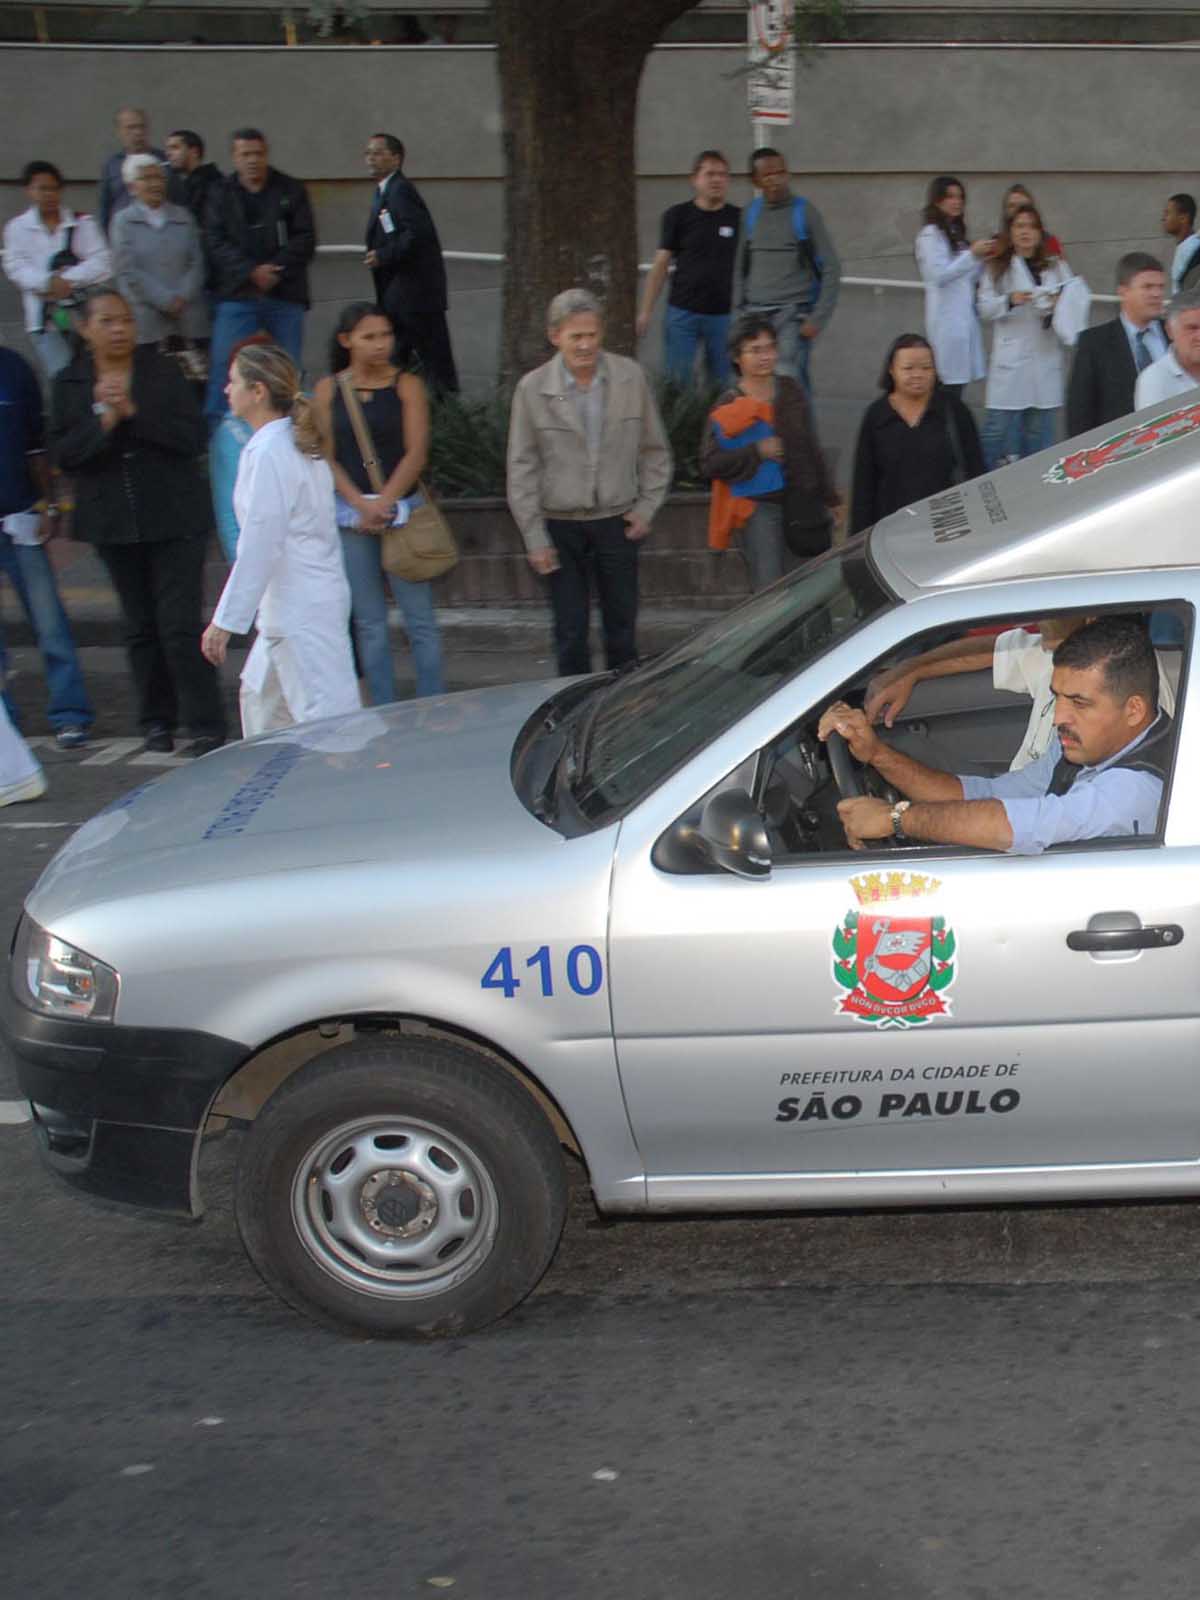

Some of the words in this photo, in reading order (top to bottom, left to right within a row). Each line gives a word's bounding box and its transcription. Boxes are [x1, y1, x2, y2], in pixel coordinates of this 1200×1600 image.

[480, 944, 603, 998] 410
[780, 1069, 883, 1086] PREFEITURA
[890, 1068, 916, 1081] DA
[922, 1064, 990, 1081] CIDADE
[995, 1063, 1020, 1077] DE
[775, 1091, 863, 1122] SÃO
[878, 1088, 1021, 1118] PAULO
